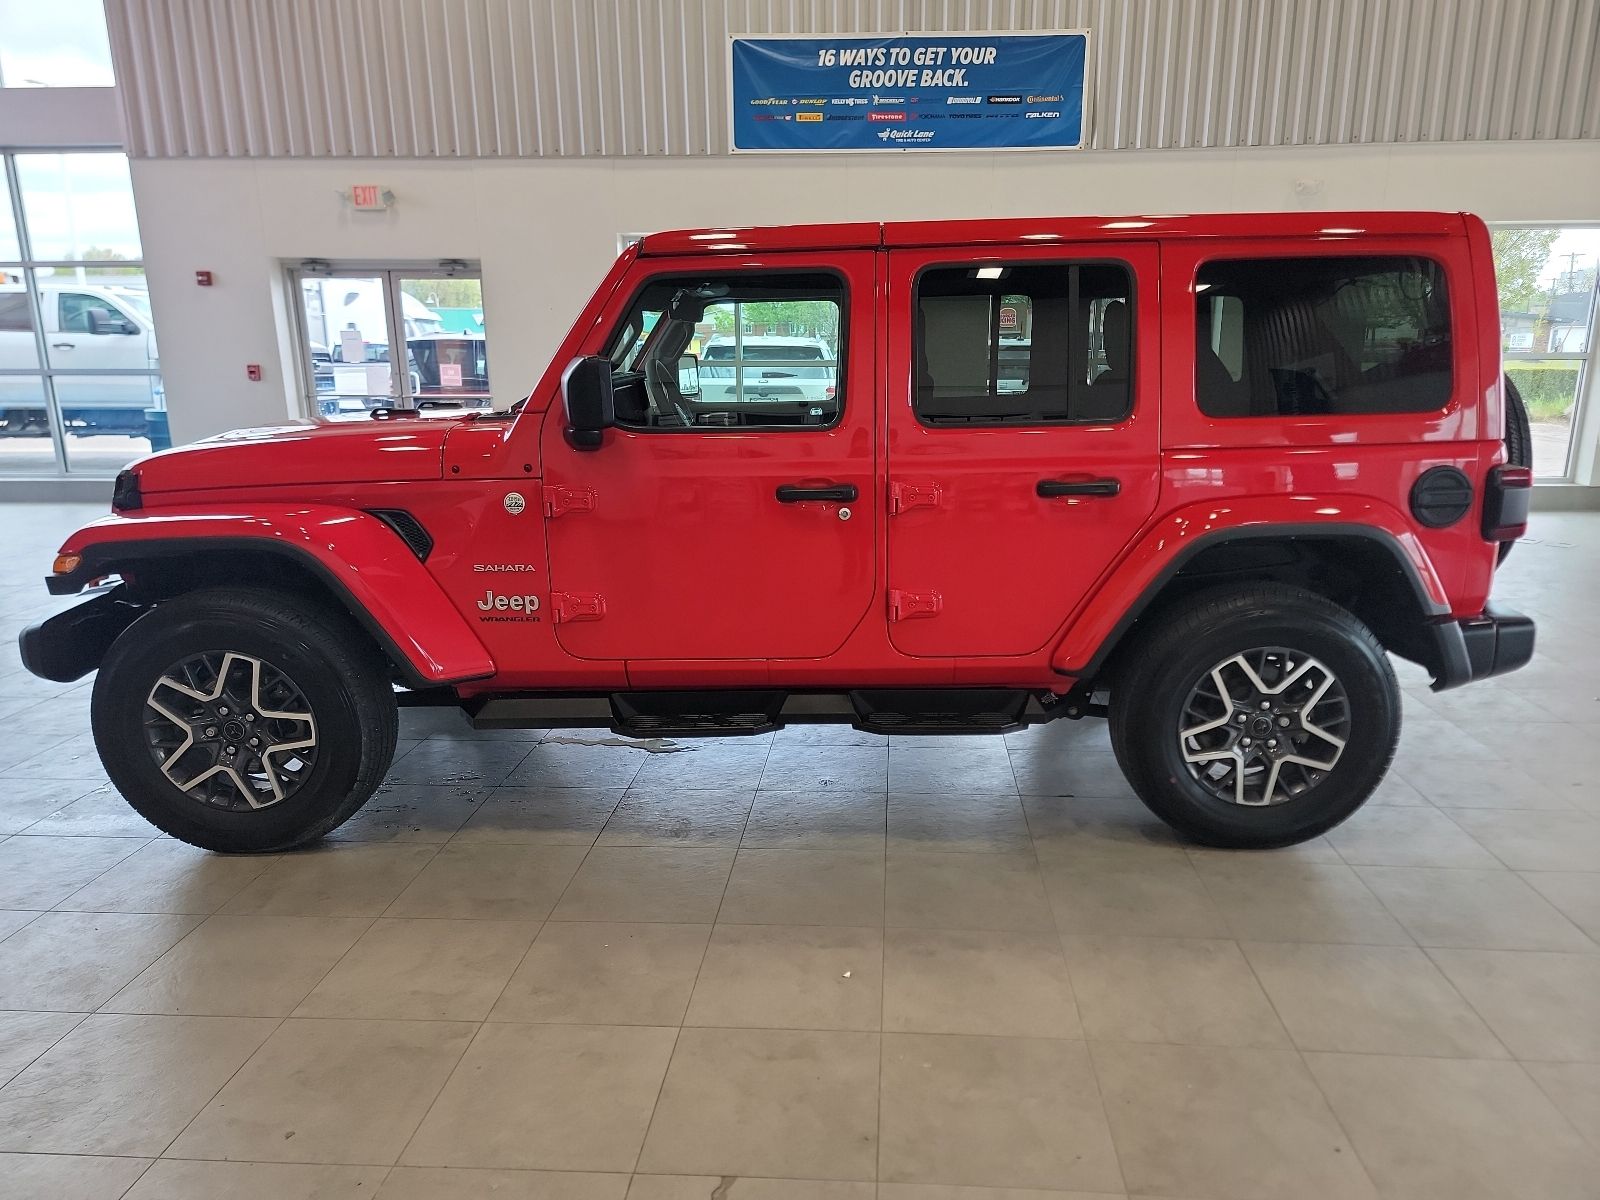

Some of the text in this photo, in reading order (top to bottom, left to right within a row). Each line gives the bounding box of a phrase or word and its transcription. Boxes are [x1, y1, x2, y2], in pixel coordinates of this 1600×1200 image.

[817, 47, 997, 67] 16 WAYS TO GET YOUR
[849, 68, 969, 88] GROOVE BACK.
[750, 97, 788, 106] GOODYEAR
[799, 98, 828, 106] DUNLOP
[1025, 111, 1060, 119] FALKEN
[890, 129, 935, 139] Quick Lane
[352, 186, 378, 207] EXIT
[473, 564, 536, 572] SAHARA
[477, 590, 539, 614] Jeep
